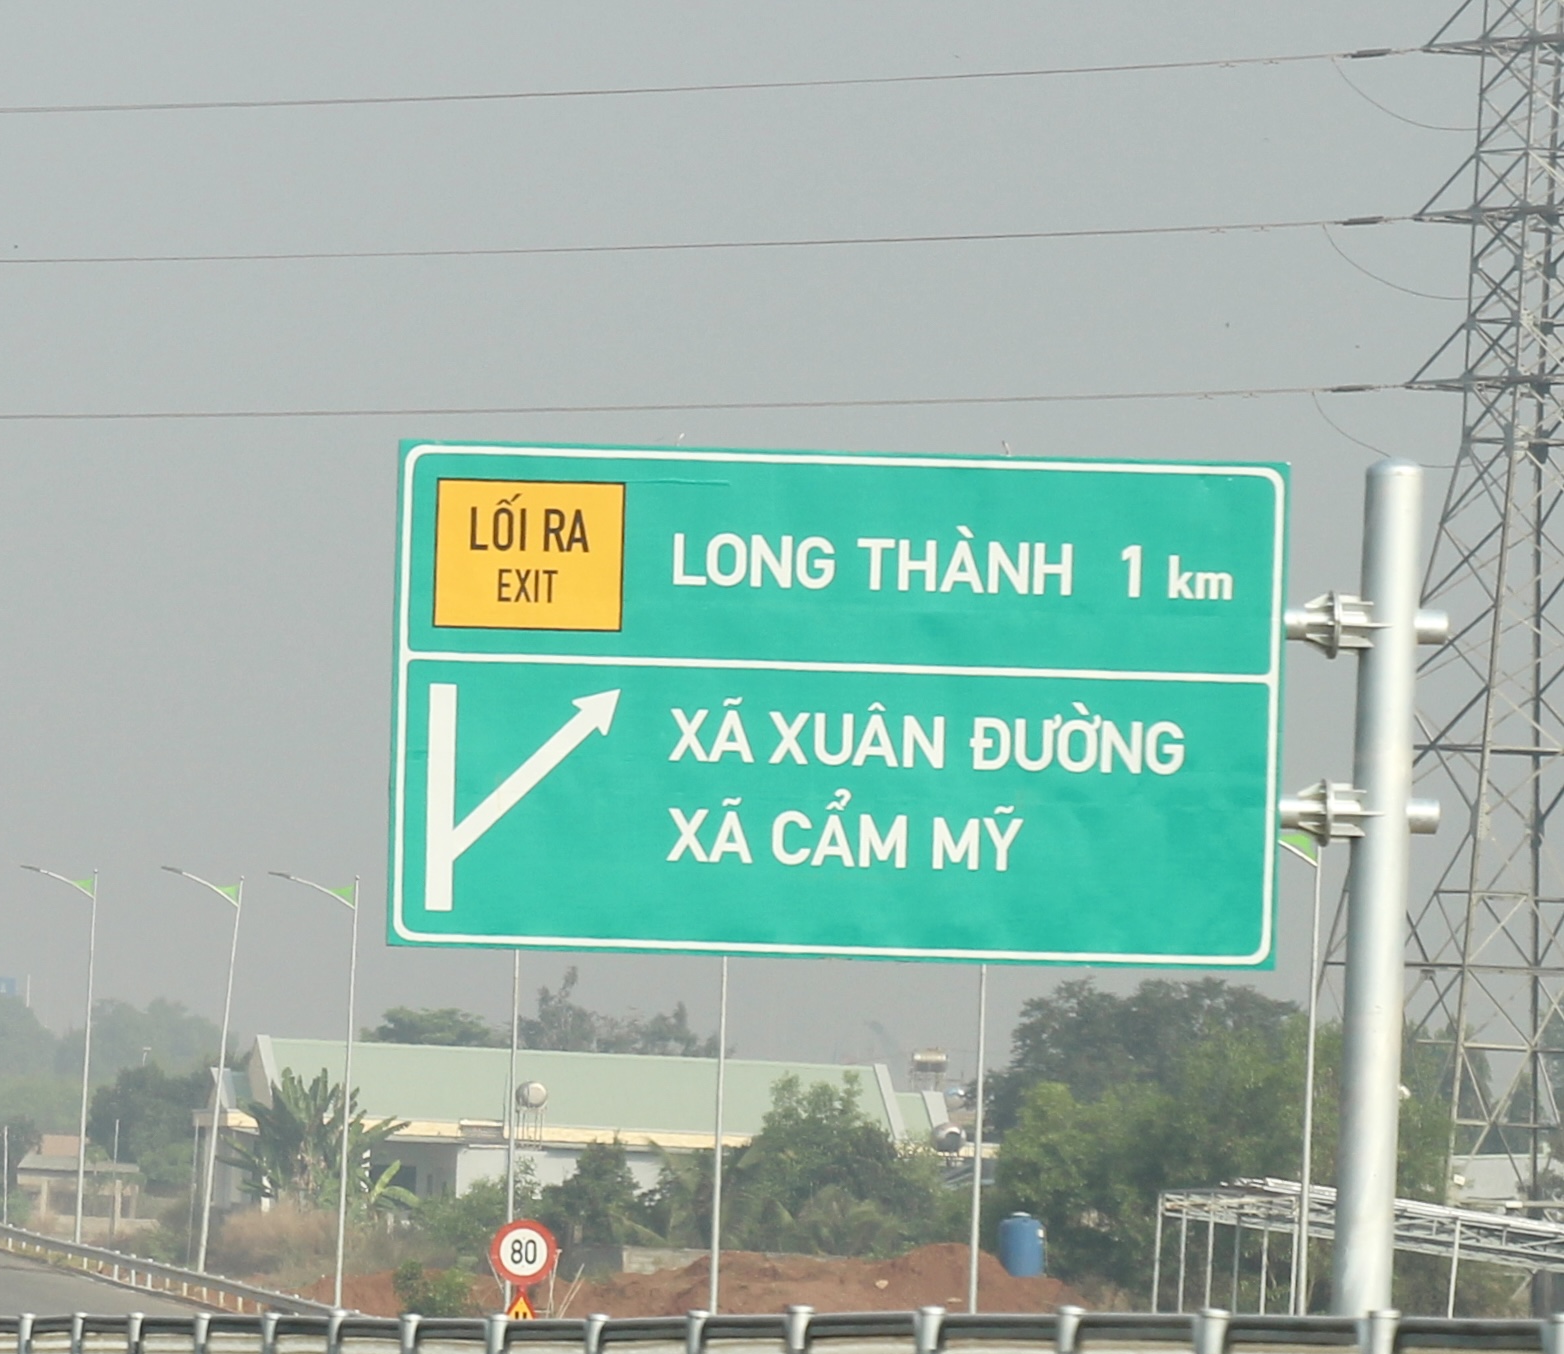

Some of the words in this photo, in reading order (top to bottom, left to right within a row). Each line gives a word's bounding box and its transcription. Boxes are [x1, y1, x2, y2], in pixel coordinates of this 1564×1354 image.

[469, 492, 527, 552] LỐI
[542, 508, 590, 553] RA
[497, 568, 559, 604] EXIT
[672, 532, 836, 590] LONG
[856, 525, 1074, 596] THÀNH
[1121, 544, 1142, 598] 1
[1167, 554, 1234, 601] km
[668, 696, 755, 763] XÃ
[768, 701, 946, 769] XUÂN
[969, 701, 1185, 775] ĐƯỜNG
[666, 796, 753, 864] XÃ
[771, 788, 908, 869] CẨM
[931, 805, 1024, 872] MỸ
[510, 1239, 537, 1265] 80
